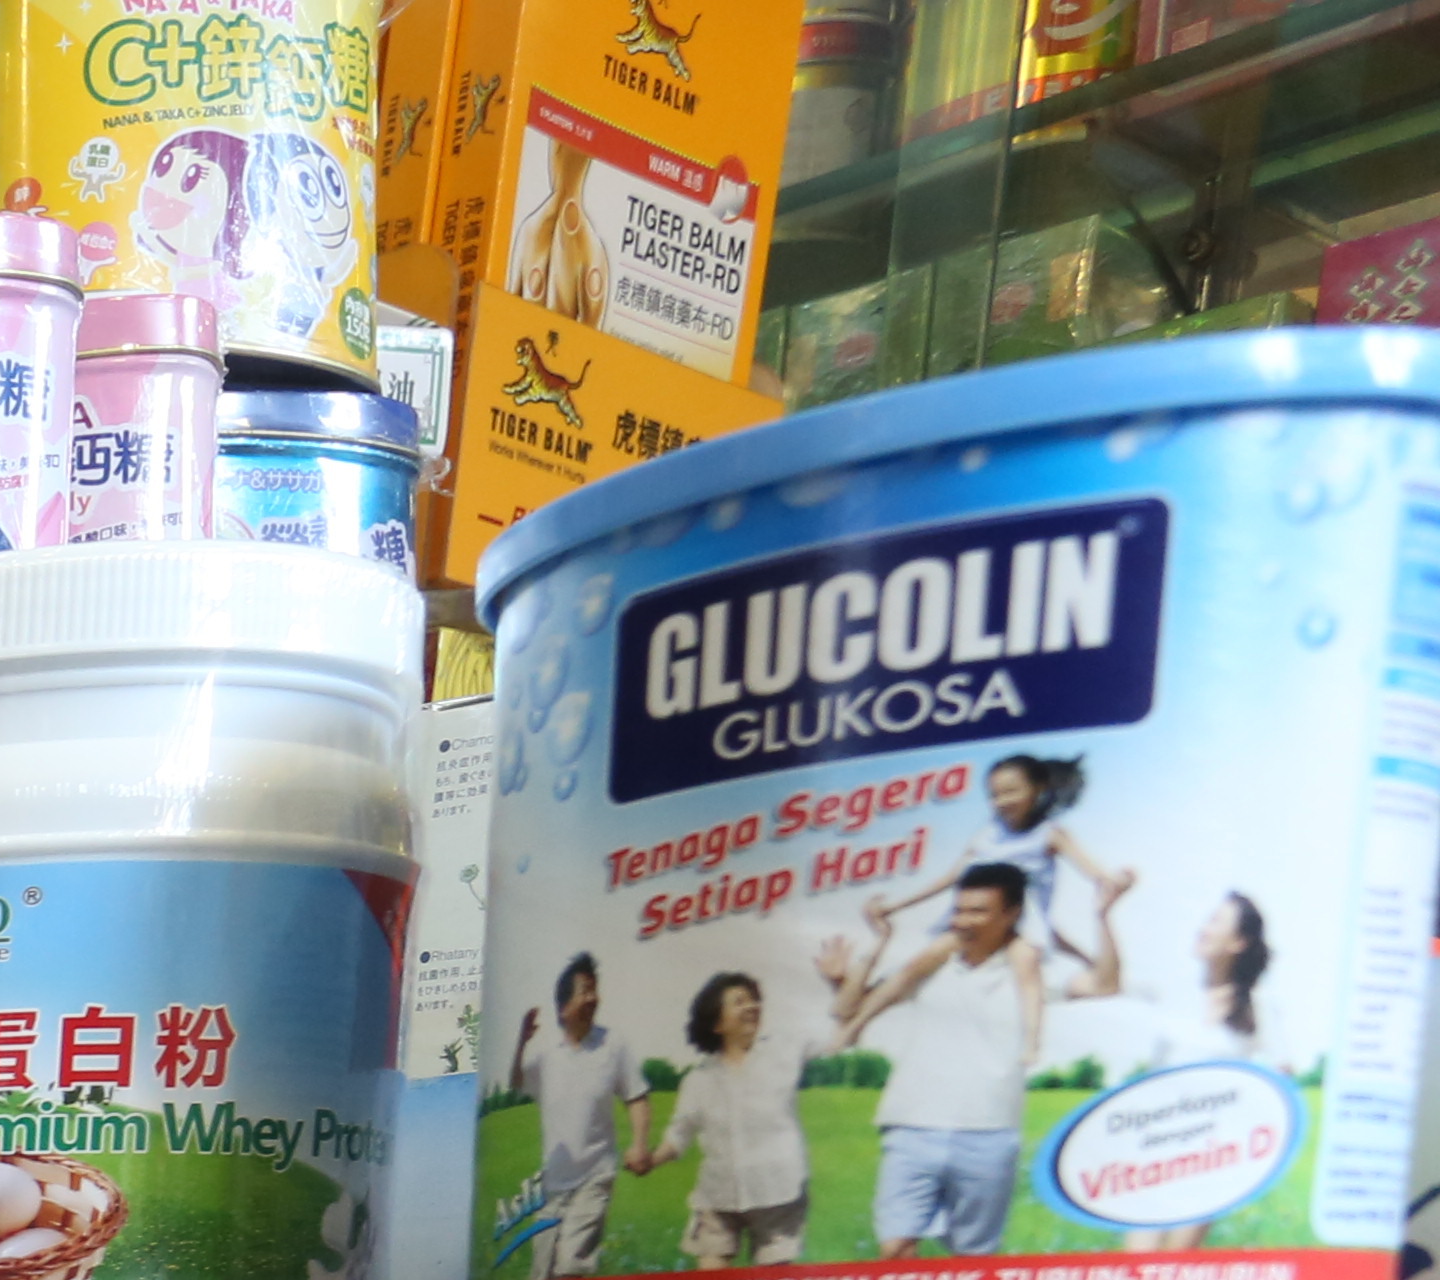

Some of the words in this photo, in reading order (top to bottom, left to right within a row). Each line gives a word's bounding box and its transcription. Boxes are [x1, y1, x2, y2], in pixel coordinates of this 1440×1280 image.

[604, 55, 644, 95] TIGER
[646, 75, 695, 116] BALM
[620, 228, 741, 294] PLASTER-RD
[626, 195, 684, 237] TIGER
[689, 222, 746, 266] BALM
[490, 407, 538, 448] TIGER
[544, 430, 588, 462] BALM
[645, 531, 1123, 721] GLUCOLIN
[713, 670, 1025, 762] GLUKOSA
[606, 810, 761, 891] Tenaga
[779, 761, 974, 846] Segera
[638, 851, 794, 941] Setiap
[810, 829, 927, 896] Hari
[167, 1101, 304, 1172] Whey
[1080, 1140, 1239, 1205] Vitamin
[1246, 1123, 1277, 1163] D
